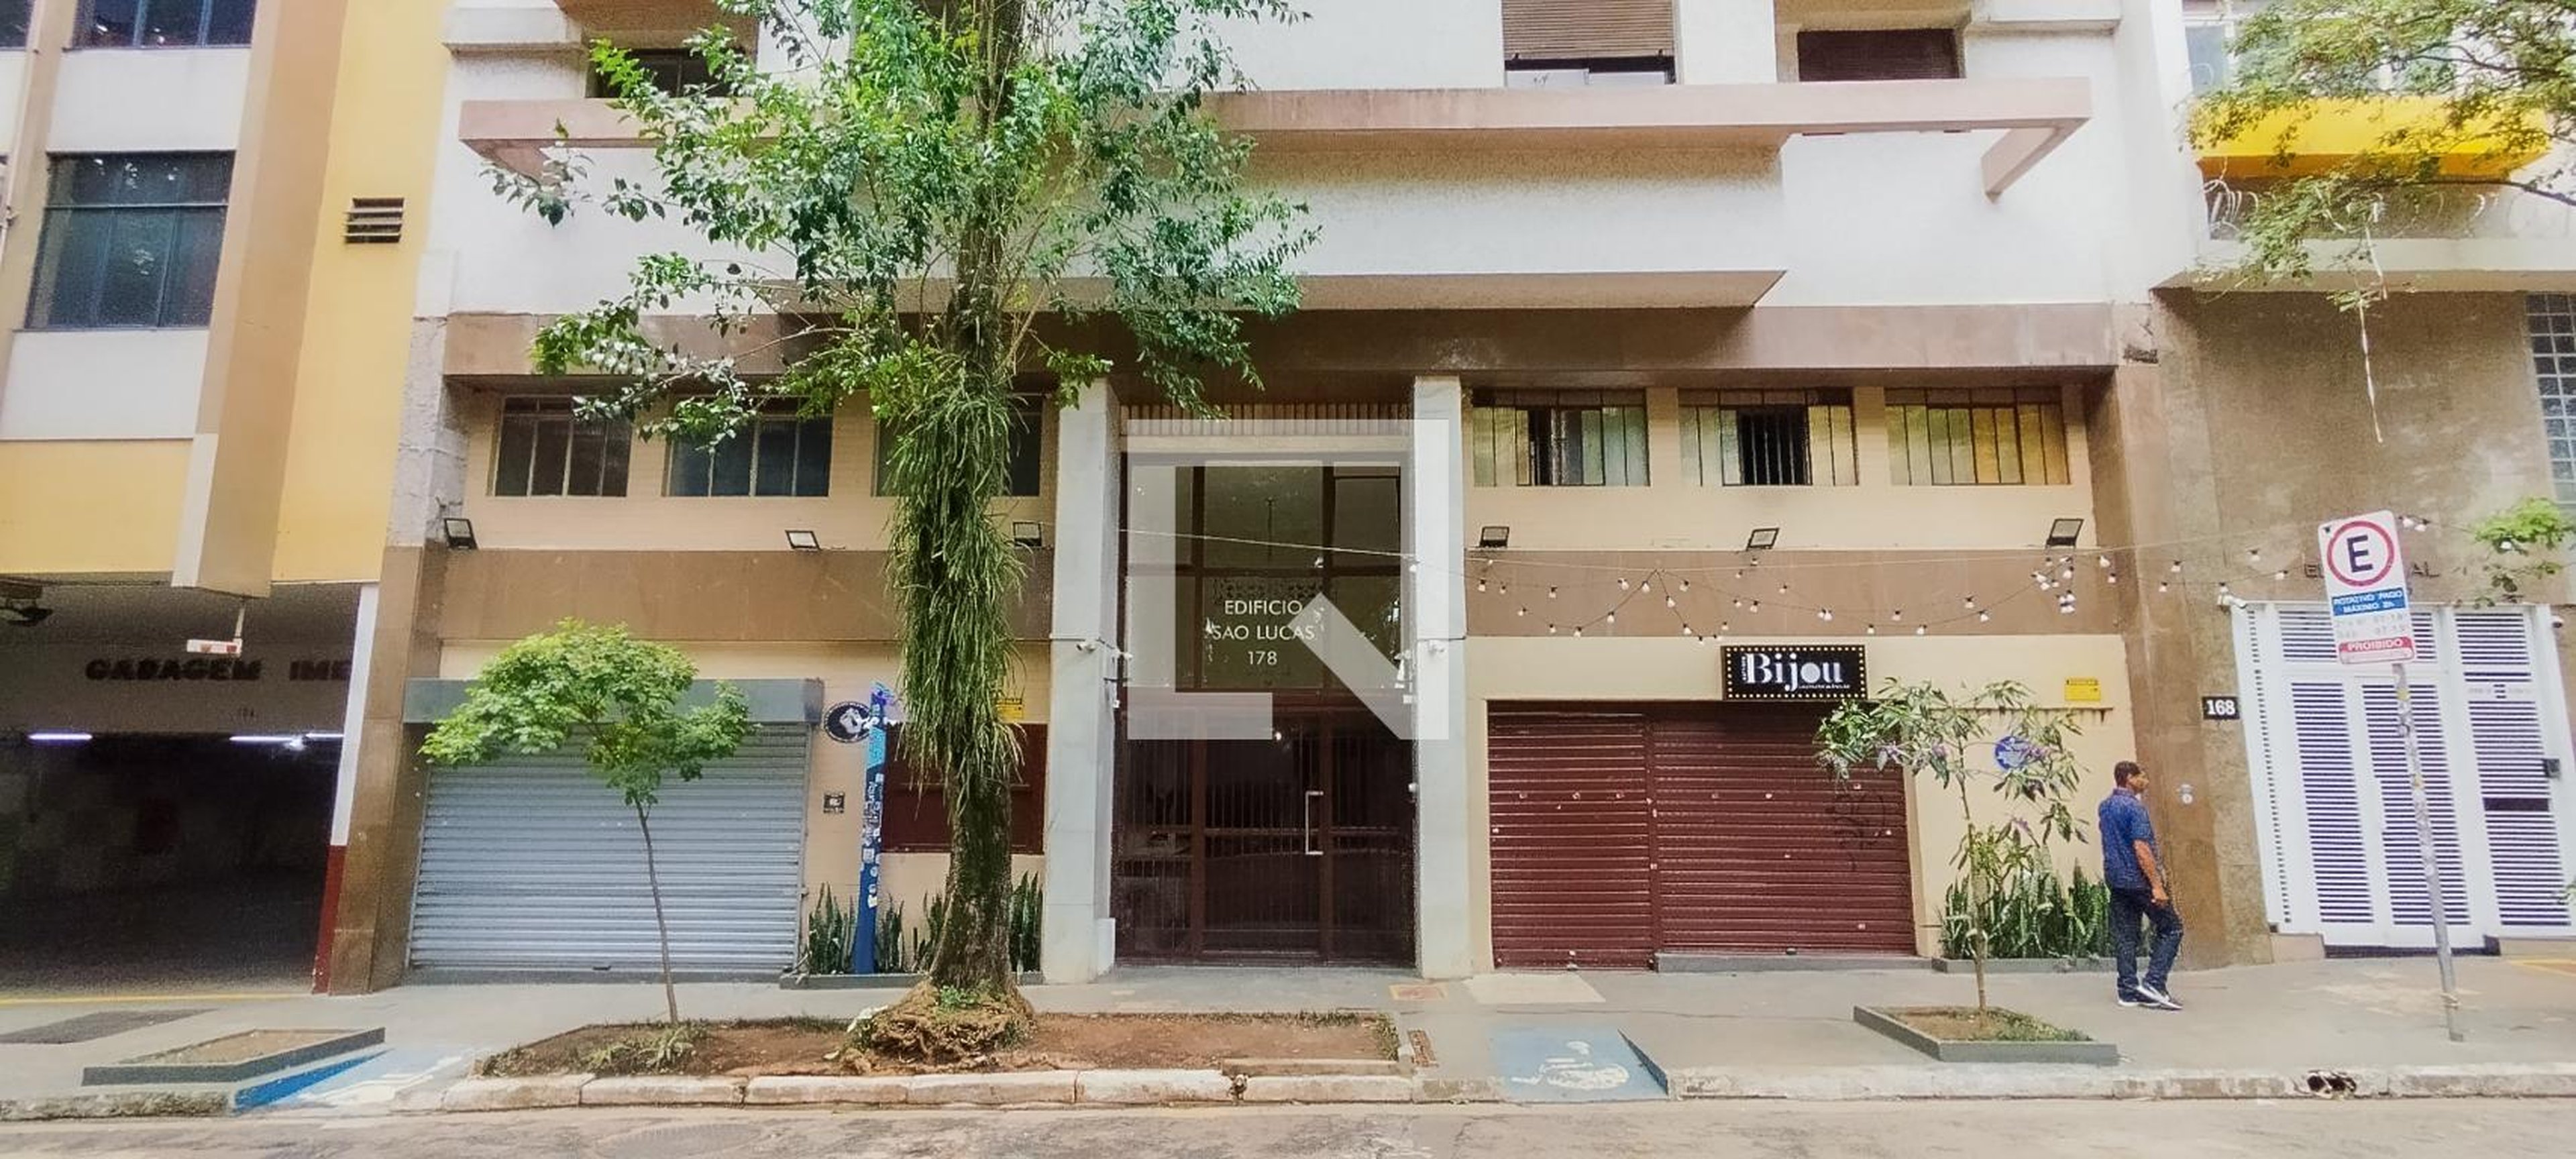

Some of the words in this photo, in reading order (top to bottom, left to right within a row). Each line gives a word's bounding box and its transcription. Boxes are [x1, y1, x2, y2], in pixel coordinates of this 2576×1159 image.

[2347, 535, 2373, 573] E
[1224, 600, 1303, 616] EDIFICIO
[2333, 594, 2375, 605] ROTATIVO
[1212, 624, 1250, 641] SAO
[1256, 624, 1316, 641] LUCAS
[2347, 639, 2404, 651] PROIBIDO
[1247, 650, 1278, 666] 178
[85, 658, 263, 681] GARAGEM
[1745, 653, 1843, 692] Bijou
[2206, 699, 2236, 716] 168
